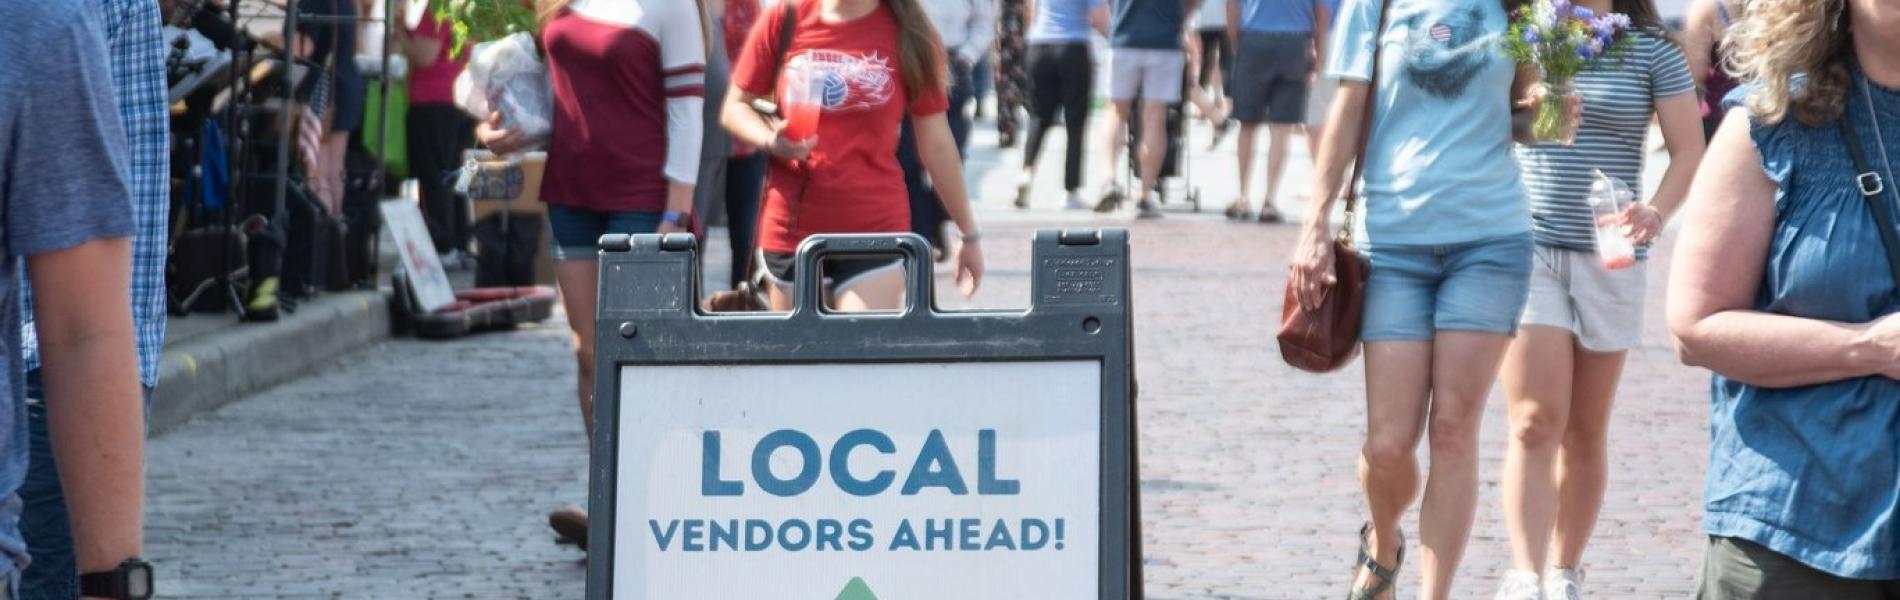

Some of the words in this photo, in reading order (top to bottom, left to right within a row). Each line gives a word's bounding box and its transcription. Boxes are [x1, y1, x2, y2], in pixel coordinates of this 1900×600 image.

[701, 428, 1020, 497] LOCAL
[648, 518, 875, 552] VENDORS
[888, 517, 1067, 552] AHEAD!
